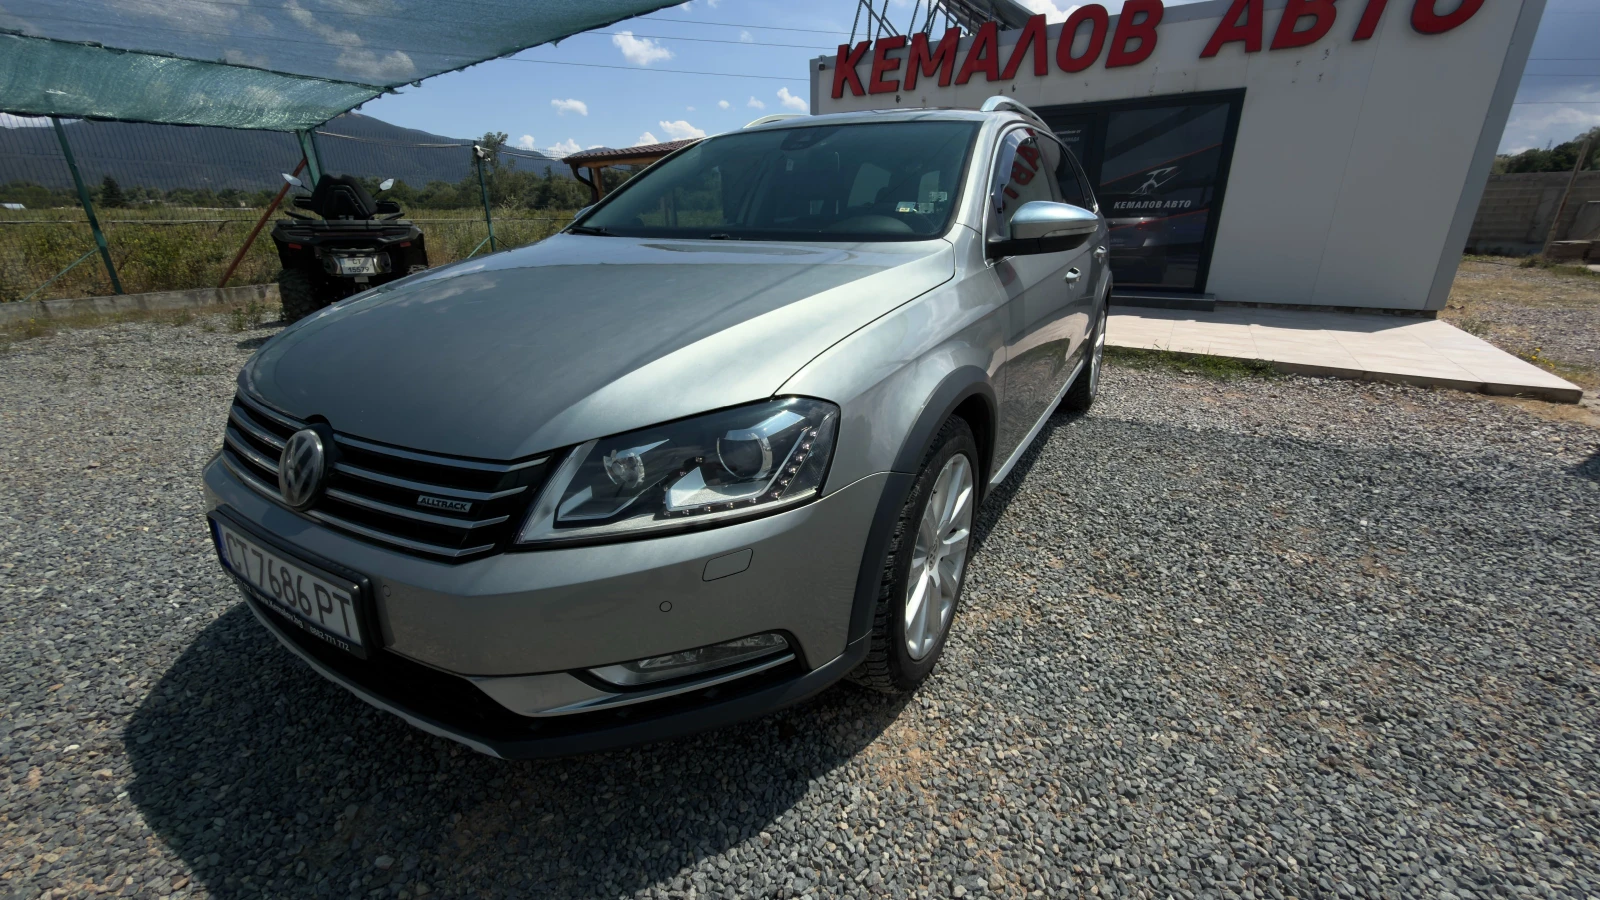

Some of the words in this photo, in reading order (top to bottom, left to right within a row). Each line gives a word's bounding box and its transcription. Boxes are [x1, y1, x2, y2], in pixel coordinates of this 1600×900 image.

[831, 0, 1164, 99] КЕМАЛОВ
[1113, 200, 1163, 209] КЕМАЛОВ
[1163, 200, 1192, 208] АВТО
[420, 497, 467, 511] ALLTRACK
